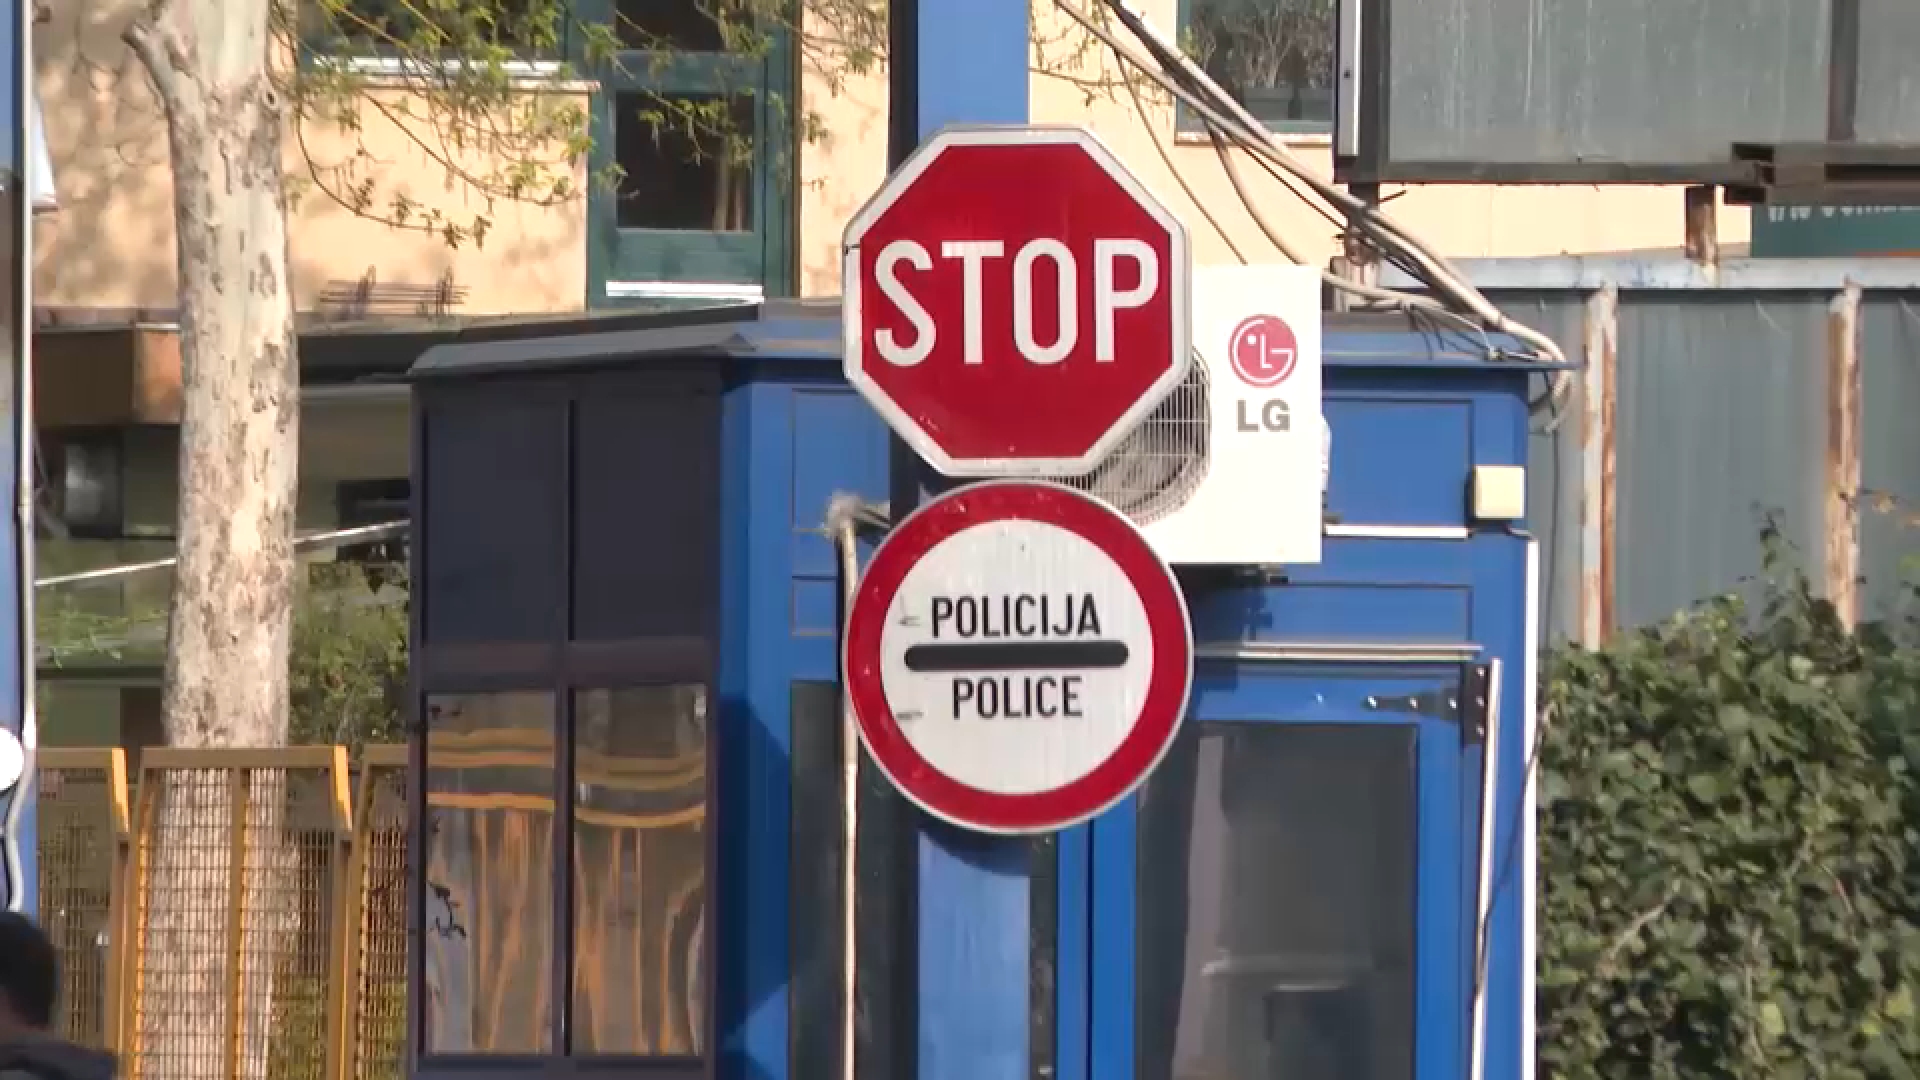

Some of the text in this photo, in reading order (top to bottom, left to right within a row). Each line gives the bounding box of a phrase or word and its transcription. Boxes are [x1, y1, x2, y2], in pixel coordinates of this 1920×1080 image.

[874, 237, 1159, 367] STOP
[1237, 398, 1291, 433] LG
[930, 592, 1101, 639] POLICIJA
[951, 675, 1083, 720] POLICE
